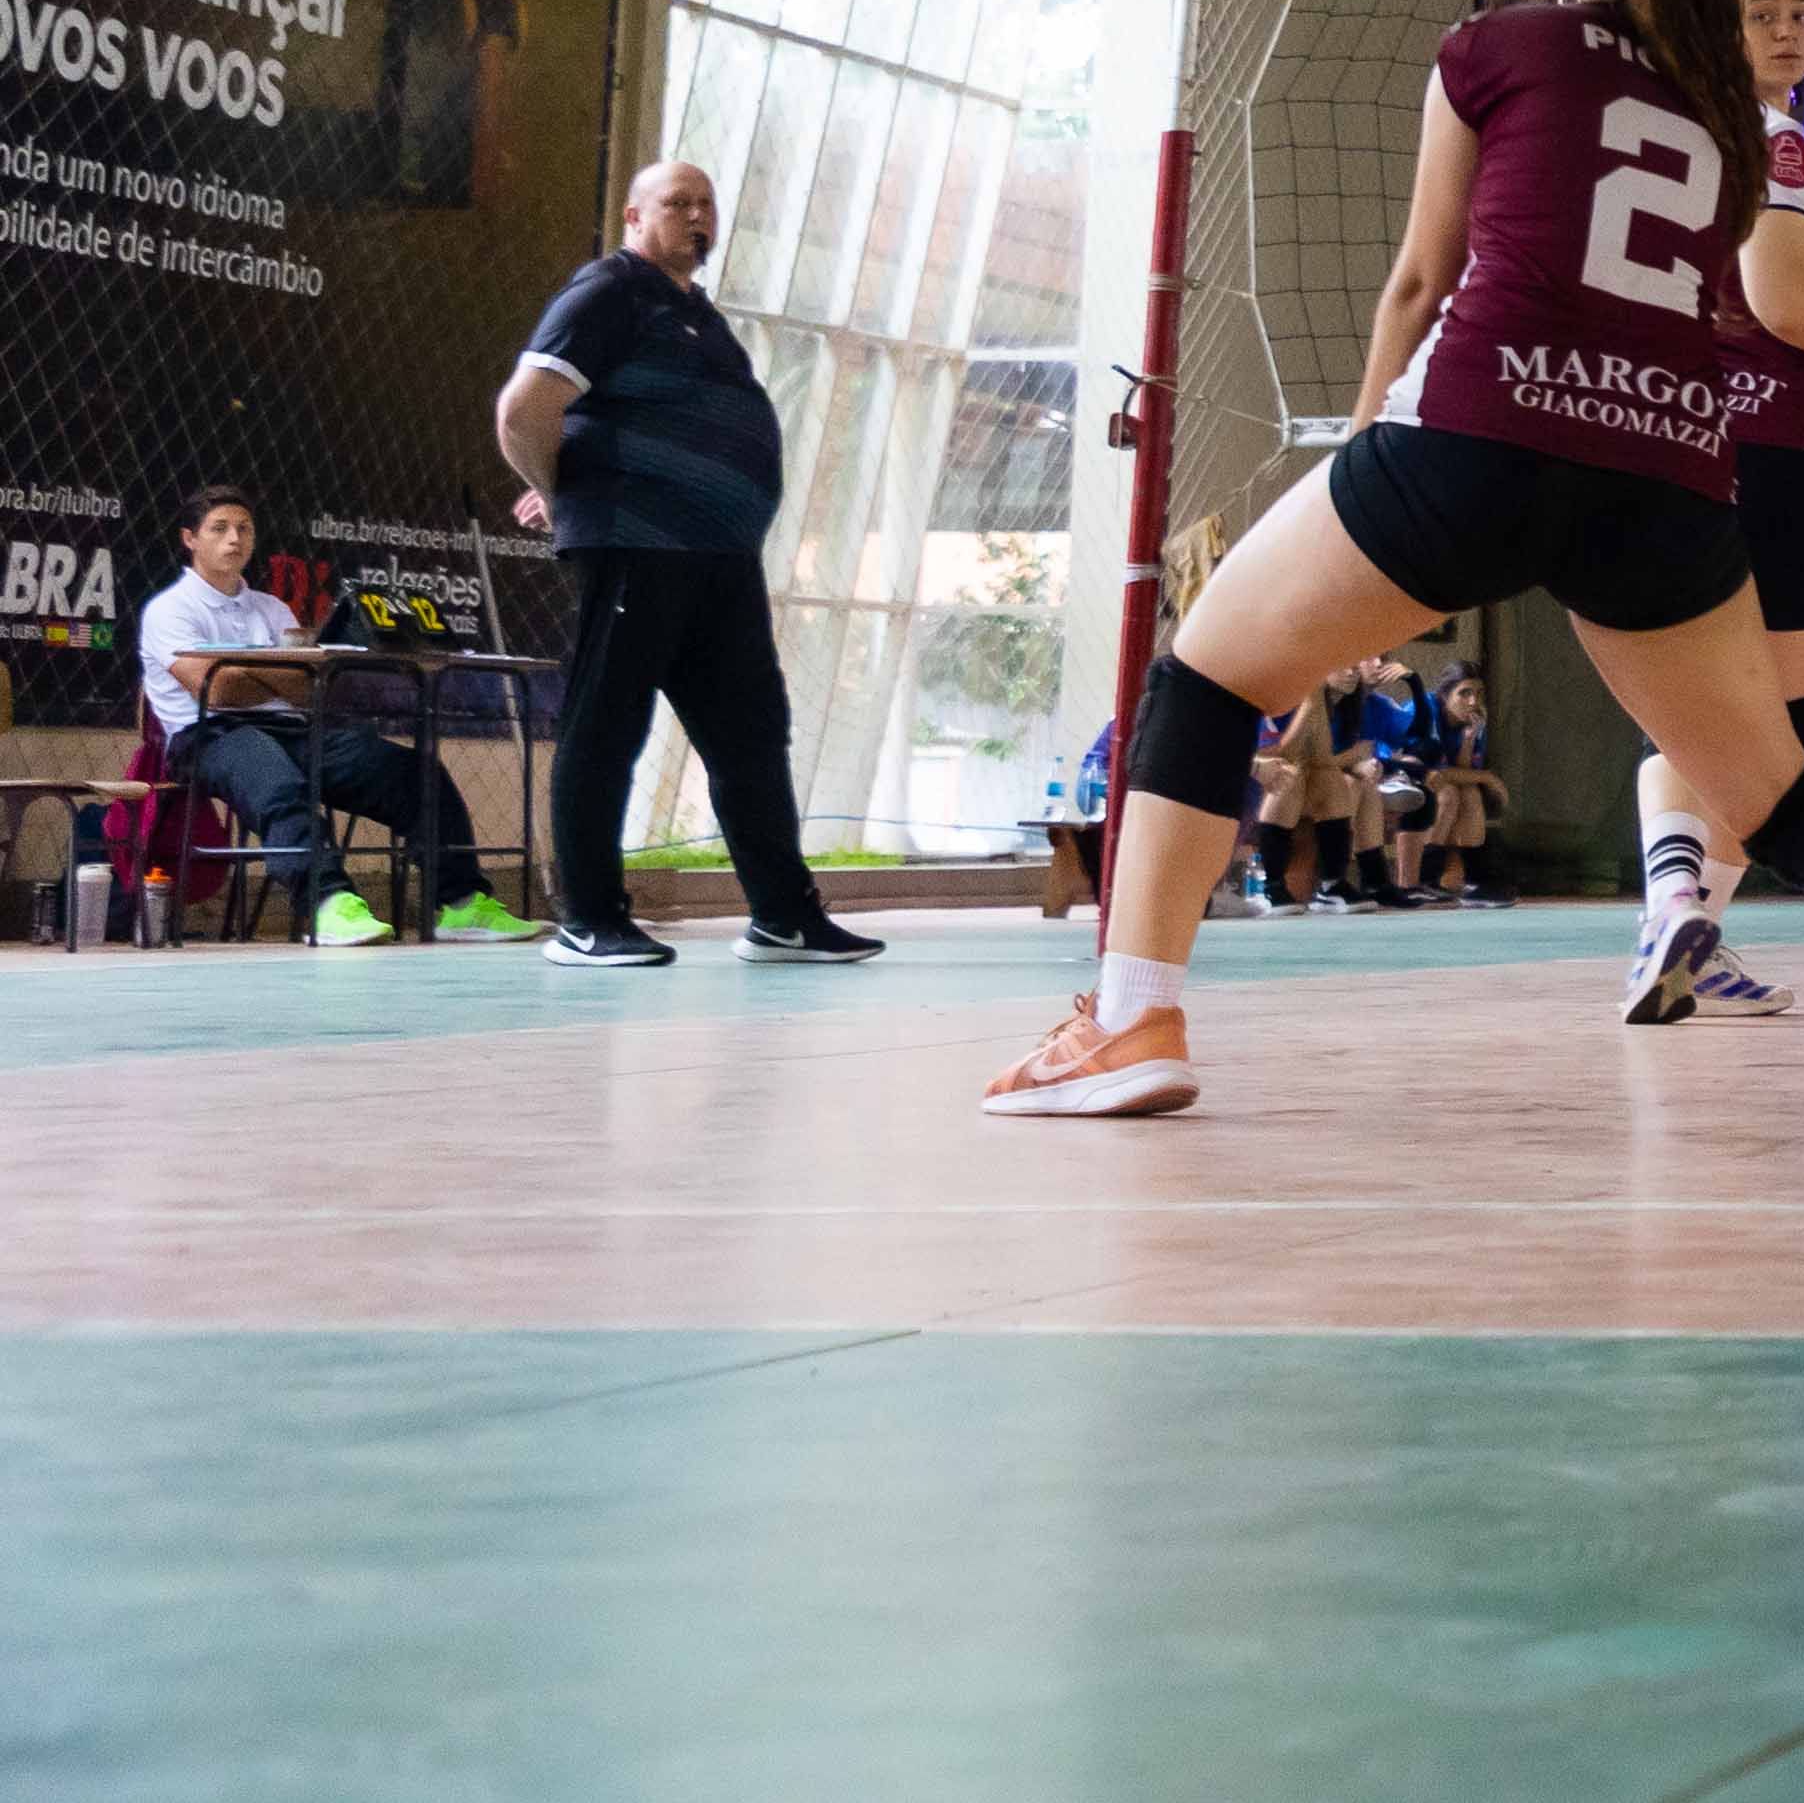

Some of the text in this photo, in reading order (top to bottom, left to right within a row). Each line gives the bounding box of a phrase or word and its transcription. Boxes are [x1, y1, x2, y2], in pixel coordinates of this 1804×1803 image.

[141, 26, 287, 128] voos
[58, 157, 106, 194] um
[113, 168, 185, 209] novo
[192, 172, 286, 230] idioma
[1581, 96, 1723, 320] 2
[118, 221, 155, 268] de
[162, 229, 325, 296] intercâmbio
[1513, 383, 1728, 458] GIACOMAZZI
[0, 540, 117, 620] BRA
[359, 592, 397, 628] 12
[409, 596, 446, 632] 12
